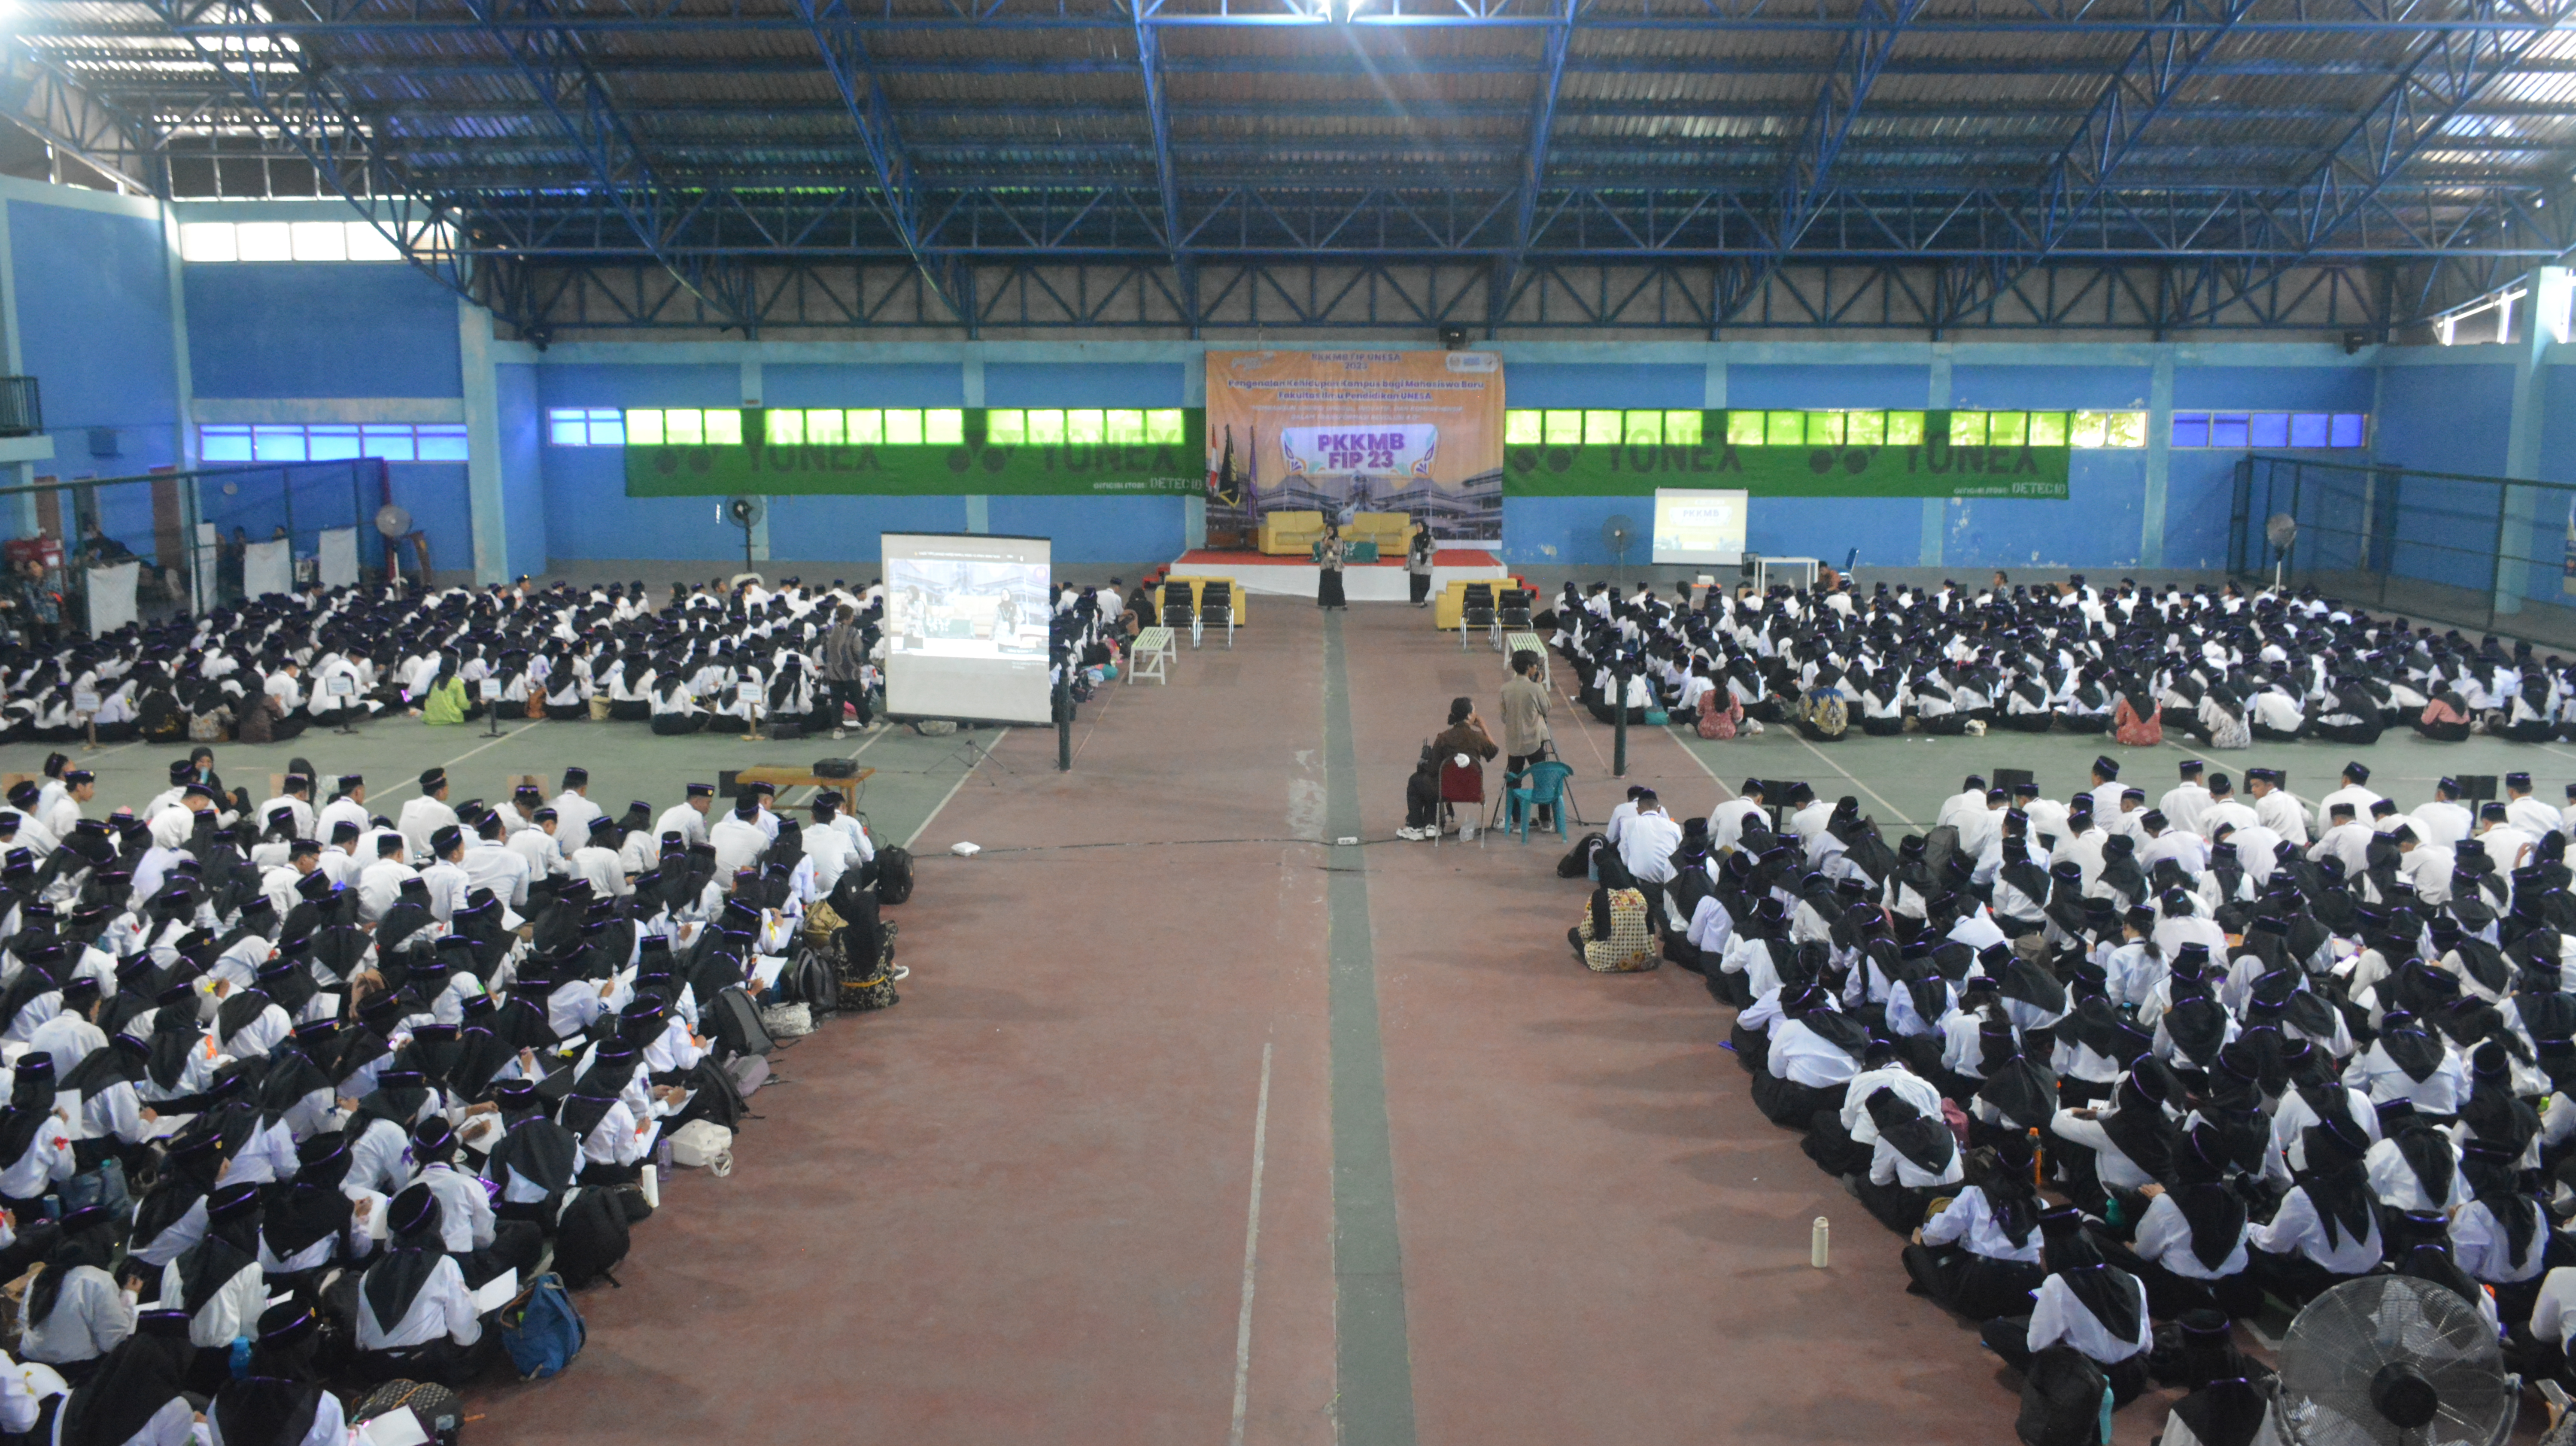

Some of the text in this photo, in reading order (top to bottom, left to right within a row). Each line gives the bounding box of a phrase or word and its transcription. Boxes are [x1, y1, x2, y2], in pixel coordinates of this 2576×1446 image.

[1228, 380, 1285, 389] Pengenalan
[1288, 380, 1339, 389] Kehidupan
[1342, 380, 1380, 389] Kampus
[1382, 380, 1403, 389] bagi
[1318, 433, 1404, 451] PKKMB
[1604, 429, 1744, 473] YONEX
[1329, 450, 1394, 469] FIP 23
[1901, 430, 2040, 474] YONEX
